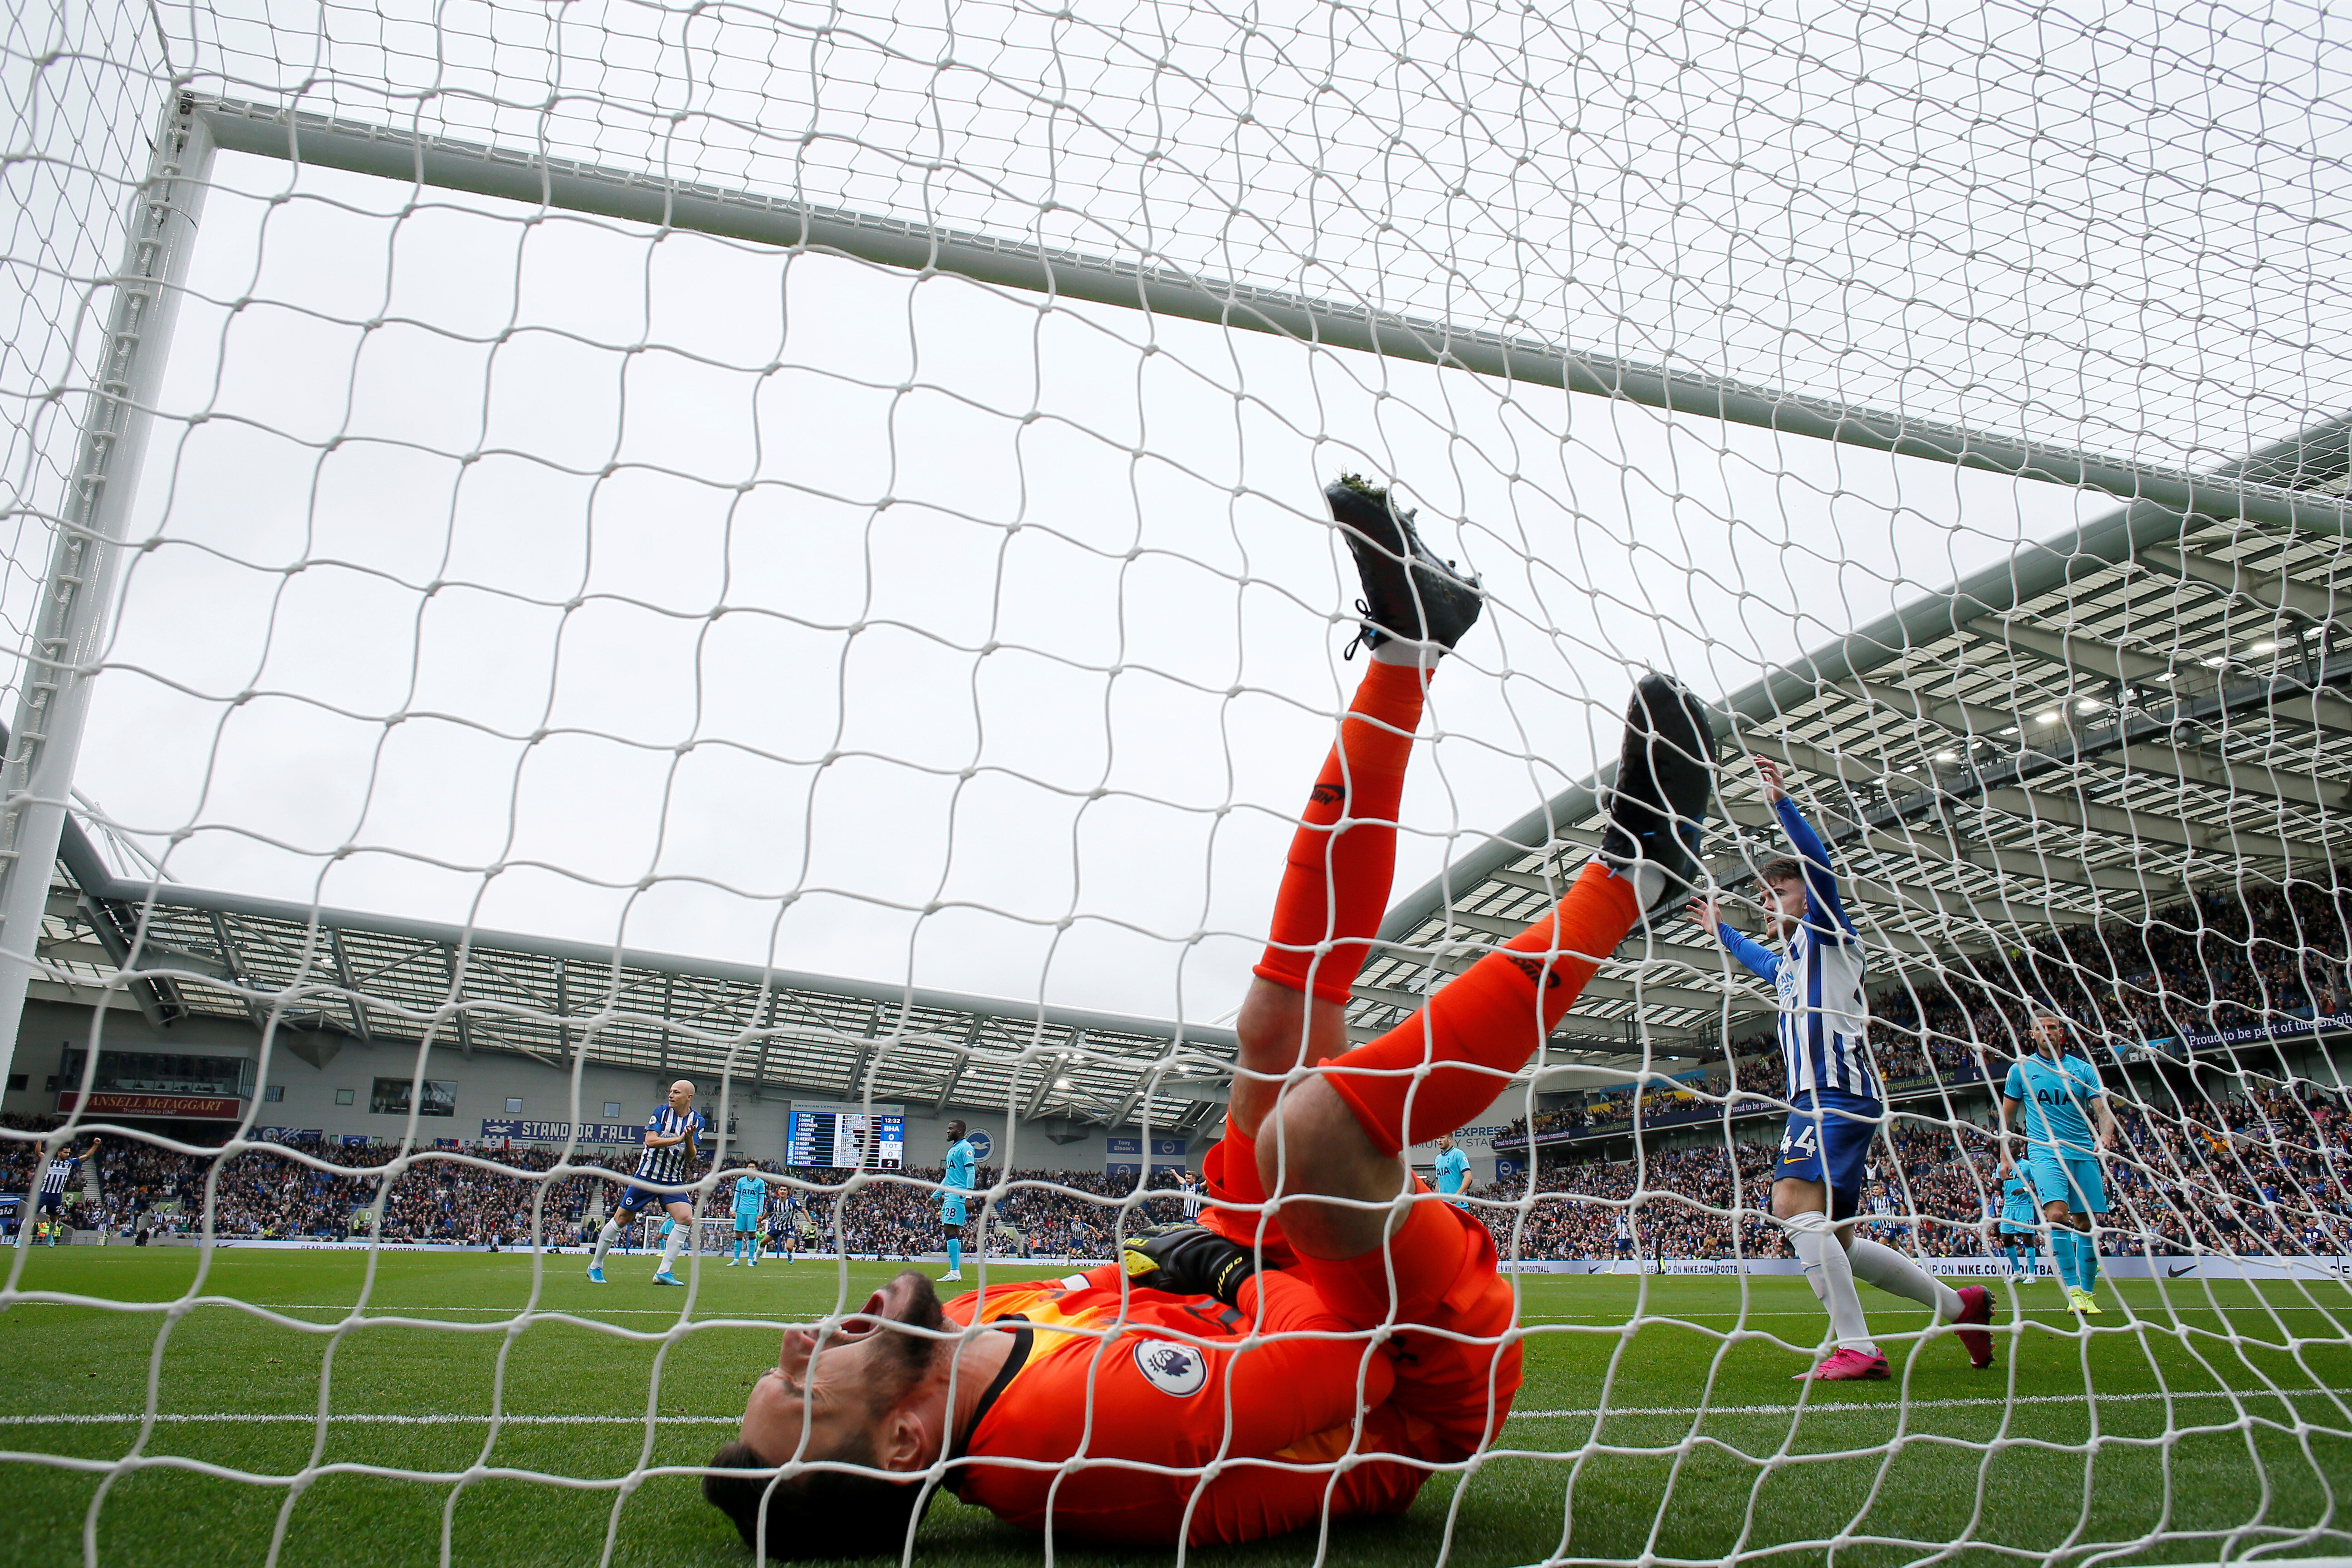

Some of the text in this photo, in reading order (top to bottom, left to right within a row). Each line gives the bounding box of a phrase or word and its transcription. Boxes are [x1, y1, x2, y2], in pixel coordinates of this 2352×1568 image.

[2189, 1034, 2220, 1046] Proud
[2224, 1031, 2234, 1041] to
[2238, 1029, 2251, 1039] be
[2280, 1021, 2293, 1033] of
[1885, 1072, 1955, 1092] itysprint.uk/BAFC
[2037, 1088, 2077, 1106] AIA
[145, 1098, 224, 1111] McTAGGART
[522, 1122, 570, 1137] STAND
[600, 1126, 636, 1140] FALL
[1548, 1131, 1569, 1140] community
[1780, 1125, 1817, 1157] 44
[1437, 1166, 1450, 1176] AIA
[365, 1212, 372, 1220] D
[945, 1208, 956, 1217] 28
[1673, 1265, 1681, 1274] ON
[1683, 1265, 1751, 1274] NIKE.COM/FOOTBLL
[1941, 1265, 1954, 1274] ON
